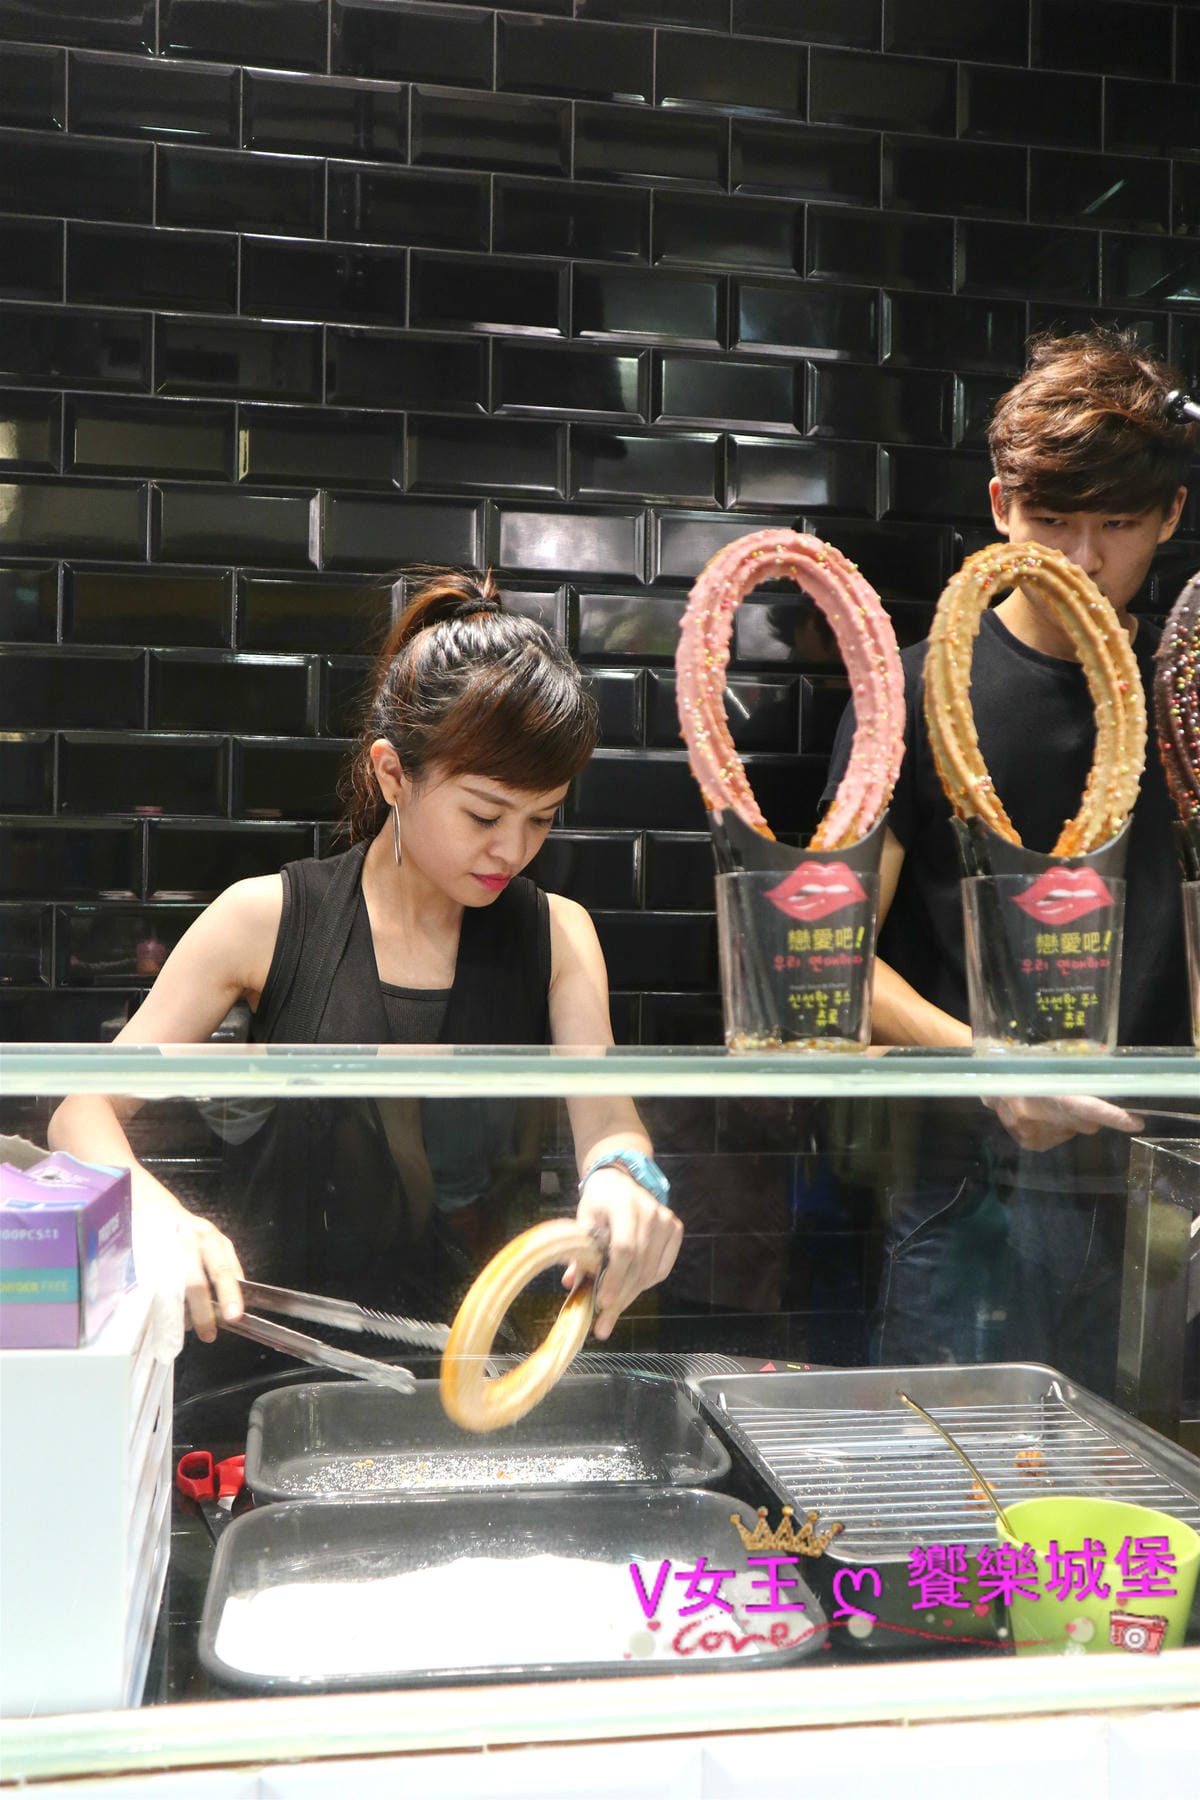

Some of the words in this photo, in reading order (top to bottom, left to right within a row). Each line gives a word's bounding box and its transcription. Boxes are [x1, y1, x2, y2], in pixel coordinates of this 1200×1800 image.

[787, 926, 865, 951] 戀愛吧!
[1035, 930, 1112, 955] 戀愛吧!
